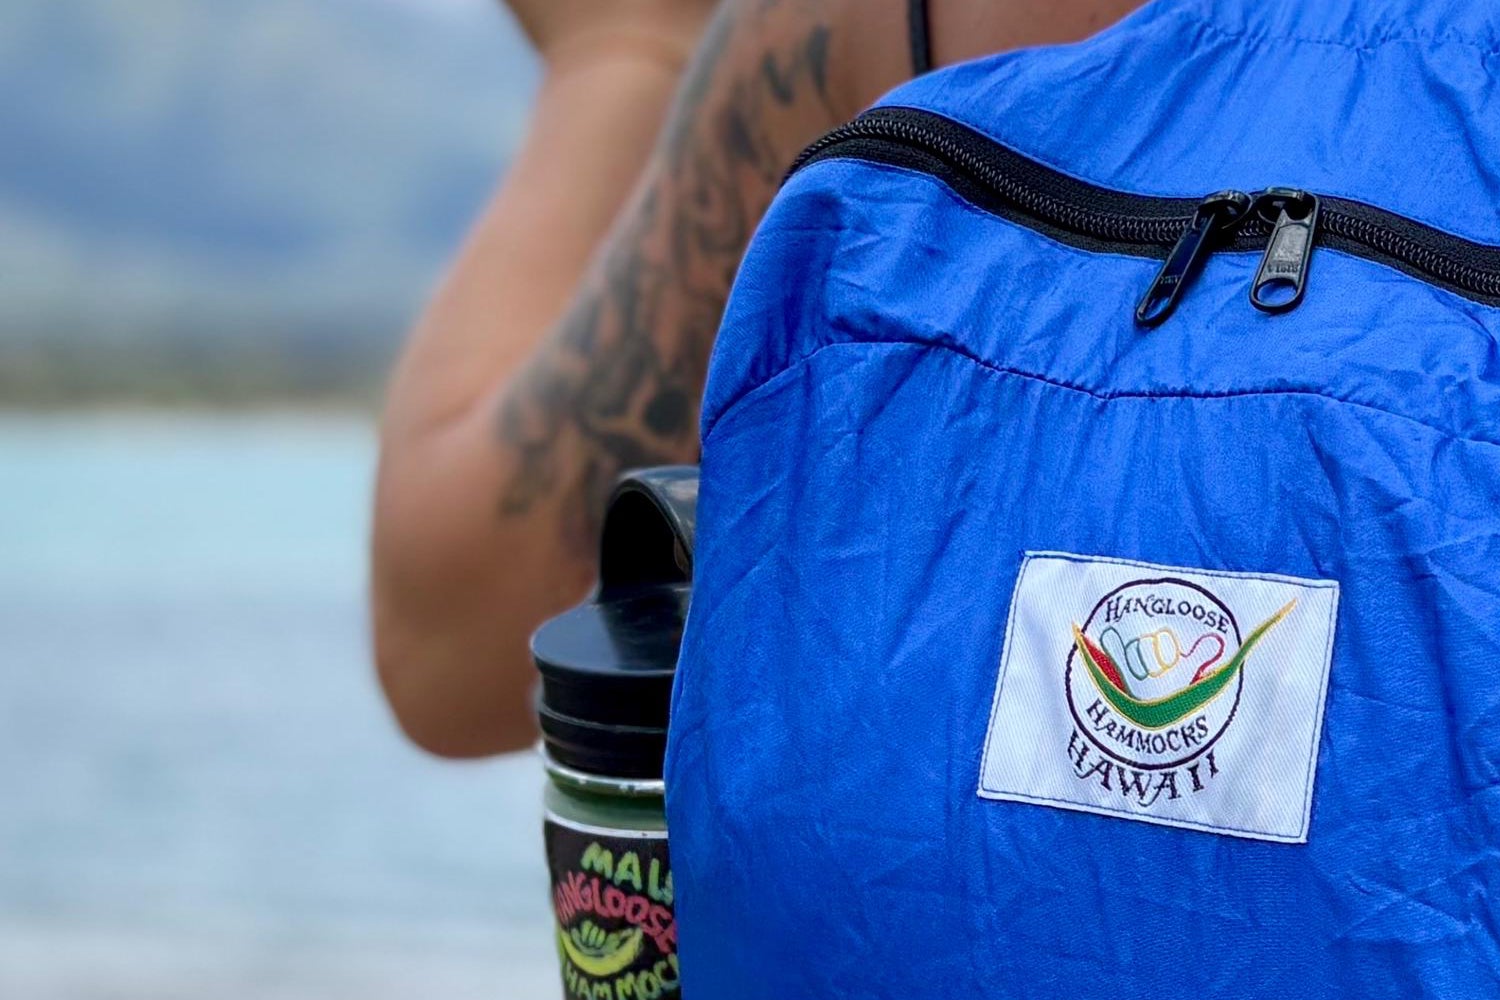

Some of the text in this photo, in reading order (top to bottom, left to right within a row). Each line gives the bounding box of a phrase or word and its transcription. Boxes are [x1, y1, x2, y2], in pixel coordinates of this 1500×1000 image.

[1105, 595, 1229, 634] HANGLOOSE
[1086, 698, 1209, 755] HAMMOCKS
[1067, 728, 1220, 807] HAWAII
